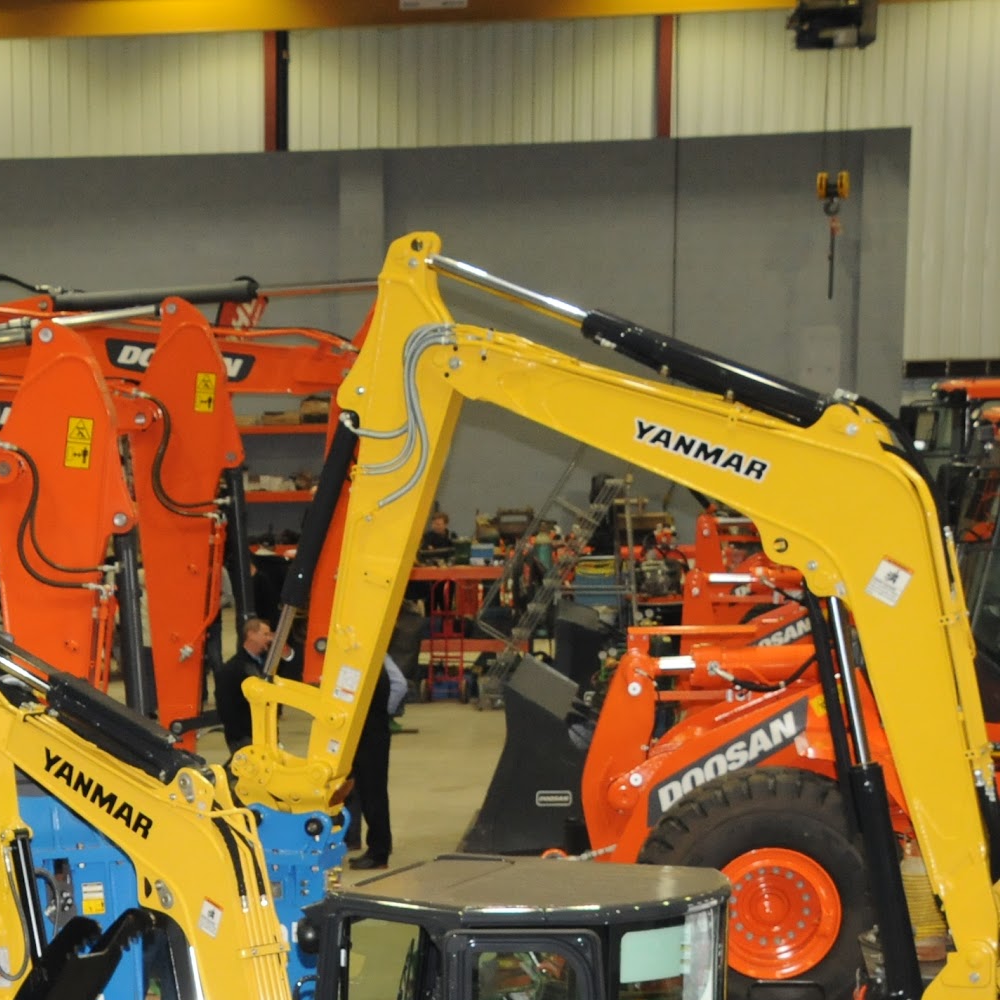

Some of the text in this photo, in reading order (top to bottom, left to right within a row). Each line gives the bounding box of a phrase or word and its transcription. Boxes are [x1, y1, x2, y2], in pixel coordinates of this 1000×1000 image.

[635, 419, 769, 481] YANMAR
[43, 746, 154, 840] YANMAR
[657, 711, 797, 812] DOOSAN
